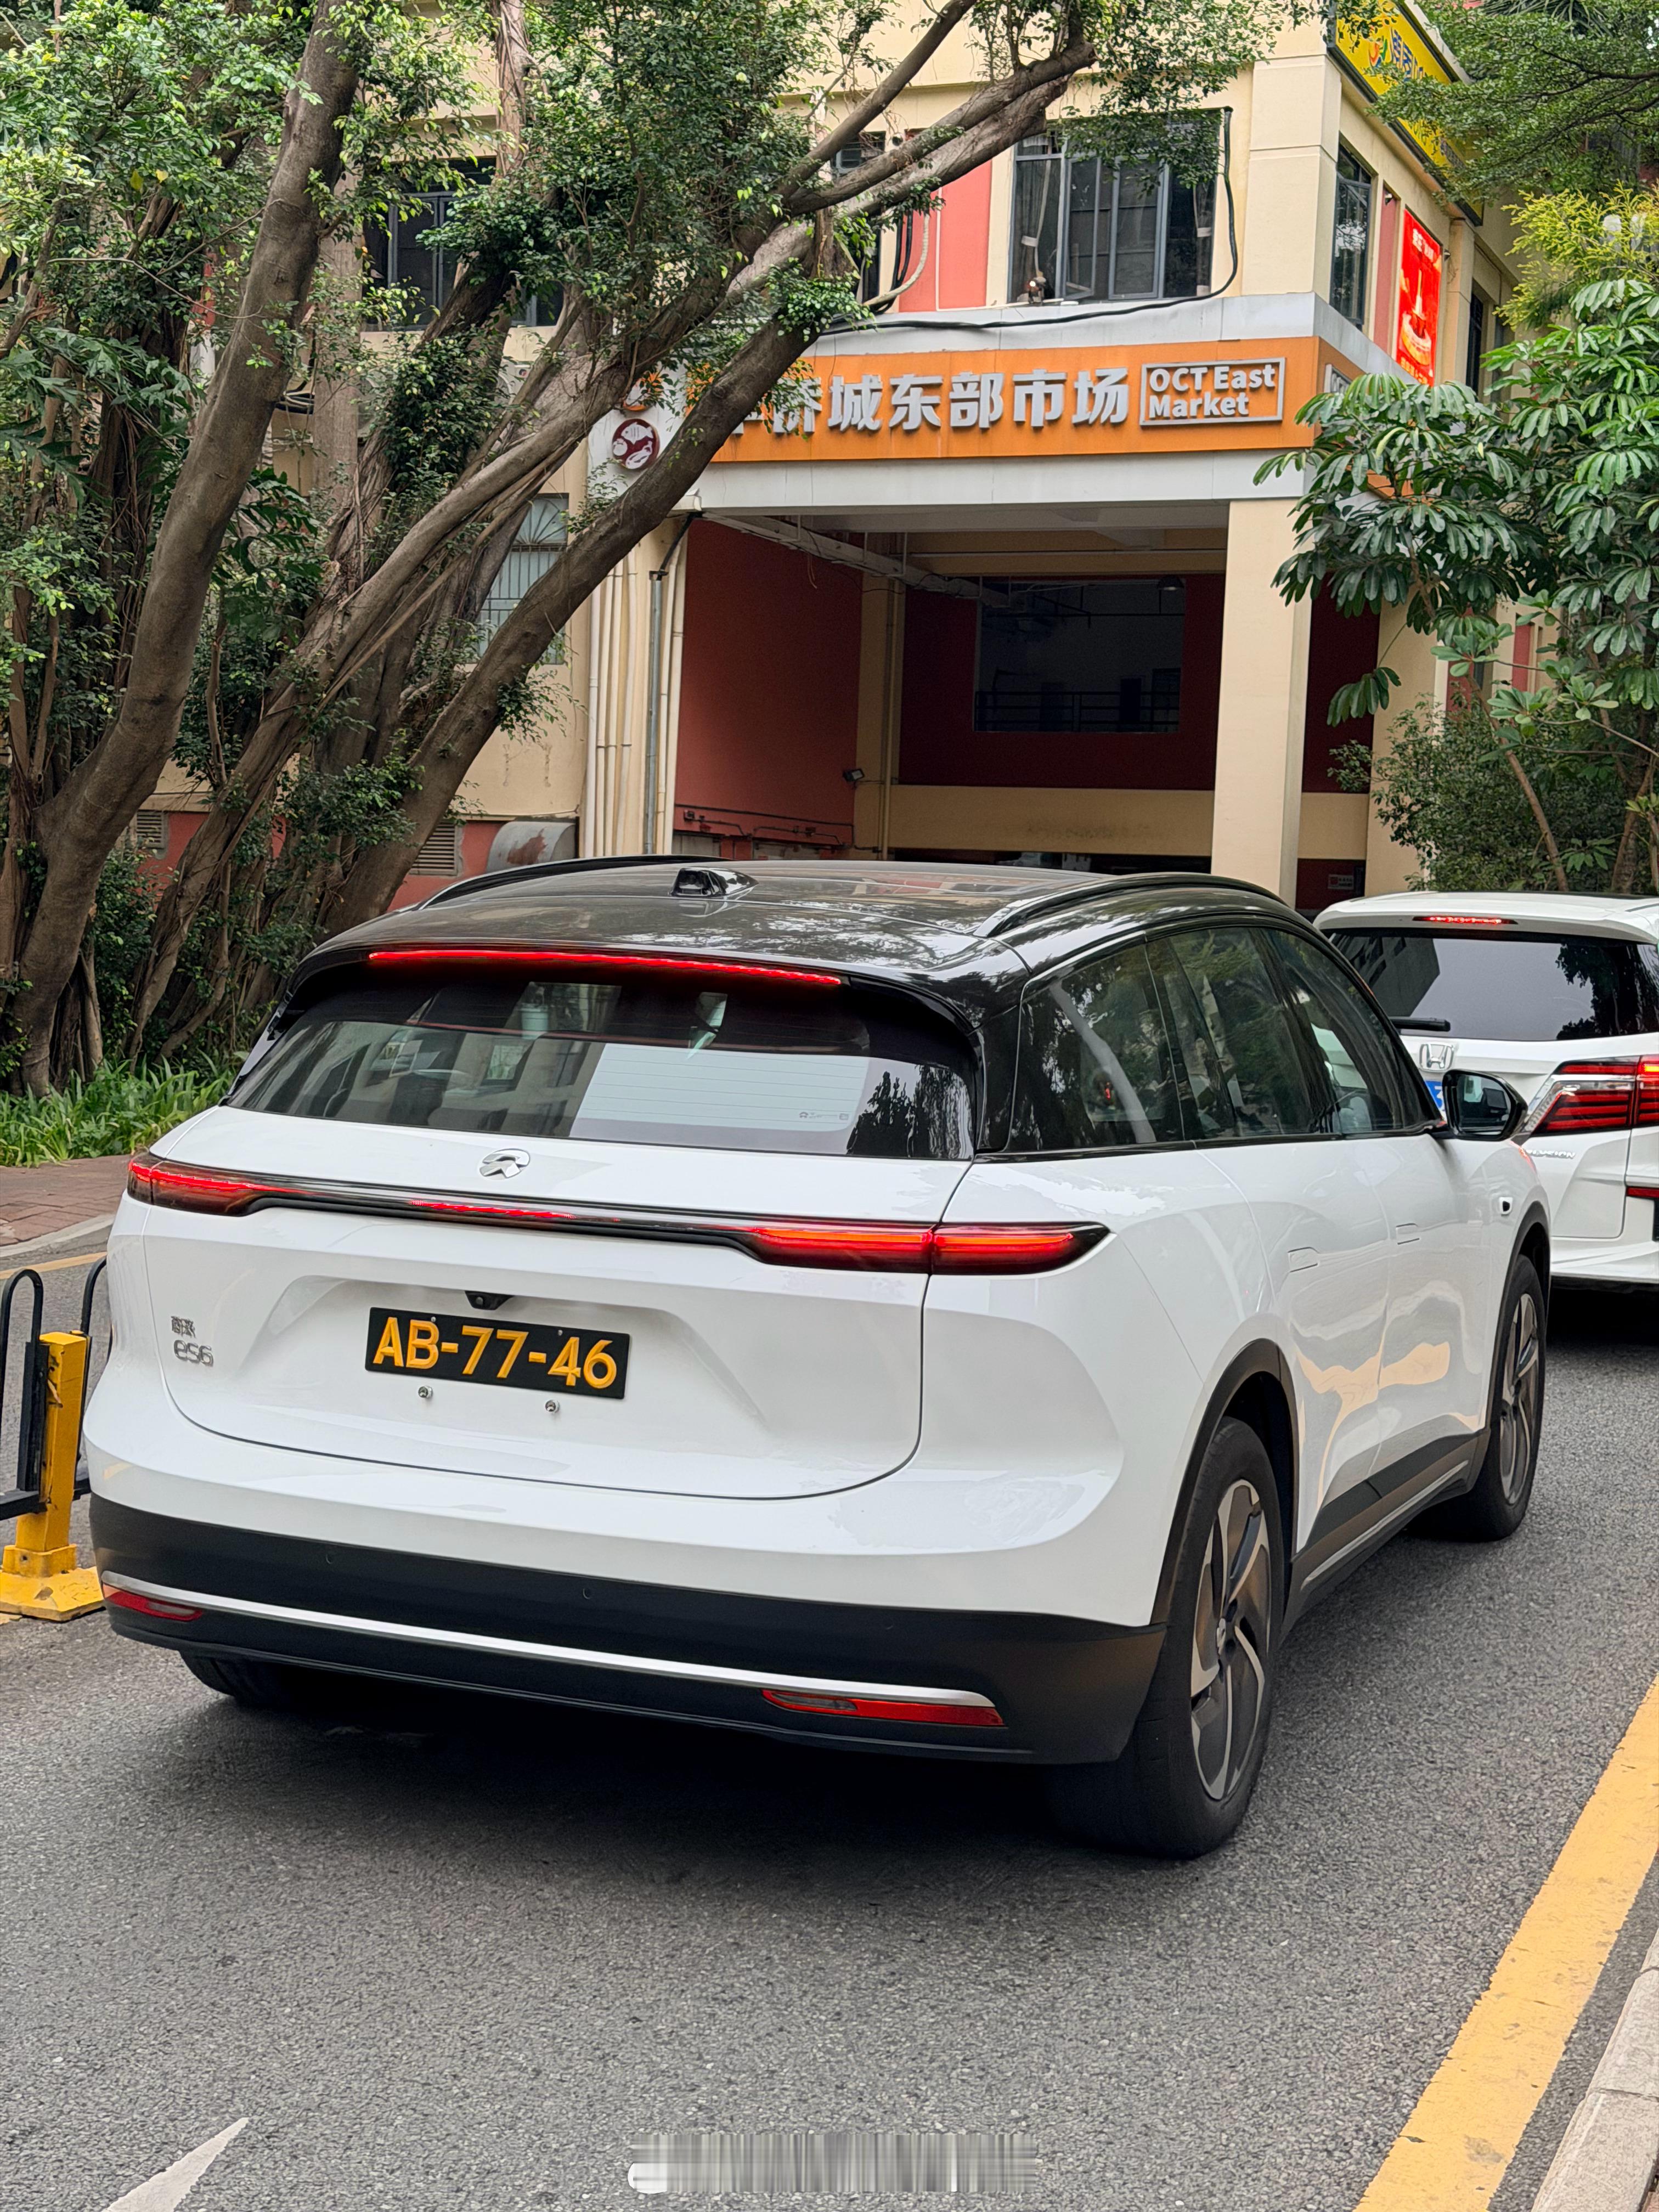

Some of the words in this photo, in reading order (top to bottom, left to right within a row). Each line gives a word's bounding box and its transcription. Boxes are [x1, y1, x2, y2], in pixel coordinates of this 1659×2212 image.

[732, 367, 1128, 435] 侨城东部市场
[1149, 367, 1208, 393] OCT
[1213, 363, 1276, 391] East
[1148, 391, 1250, 419] Market
[373, 1317, 617, 1390] AB-77-46
